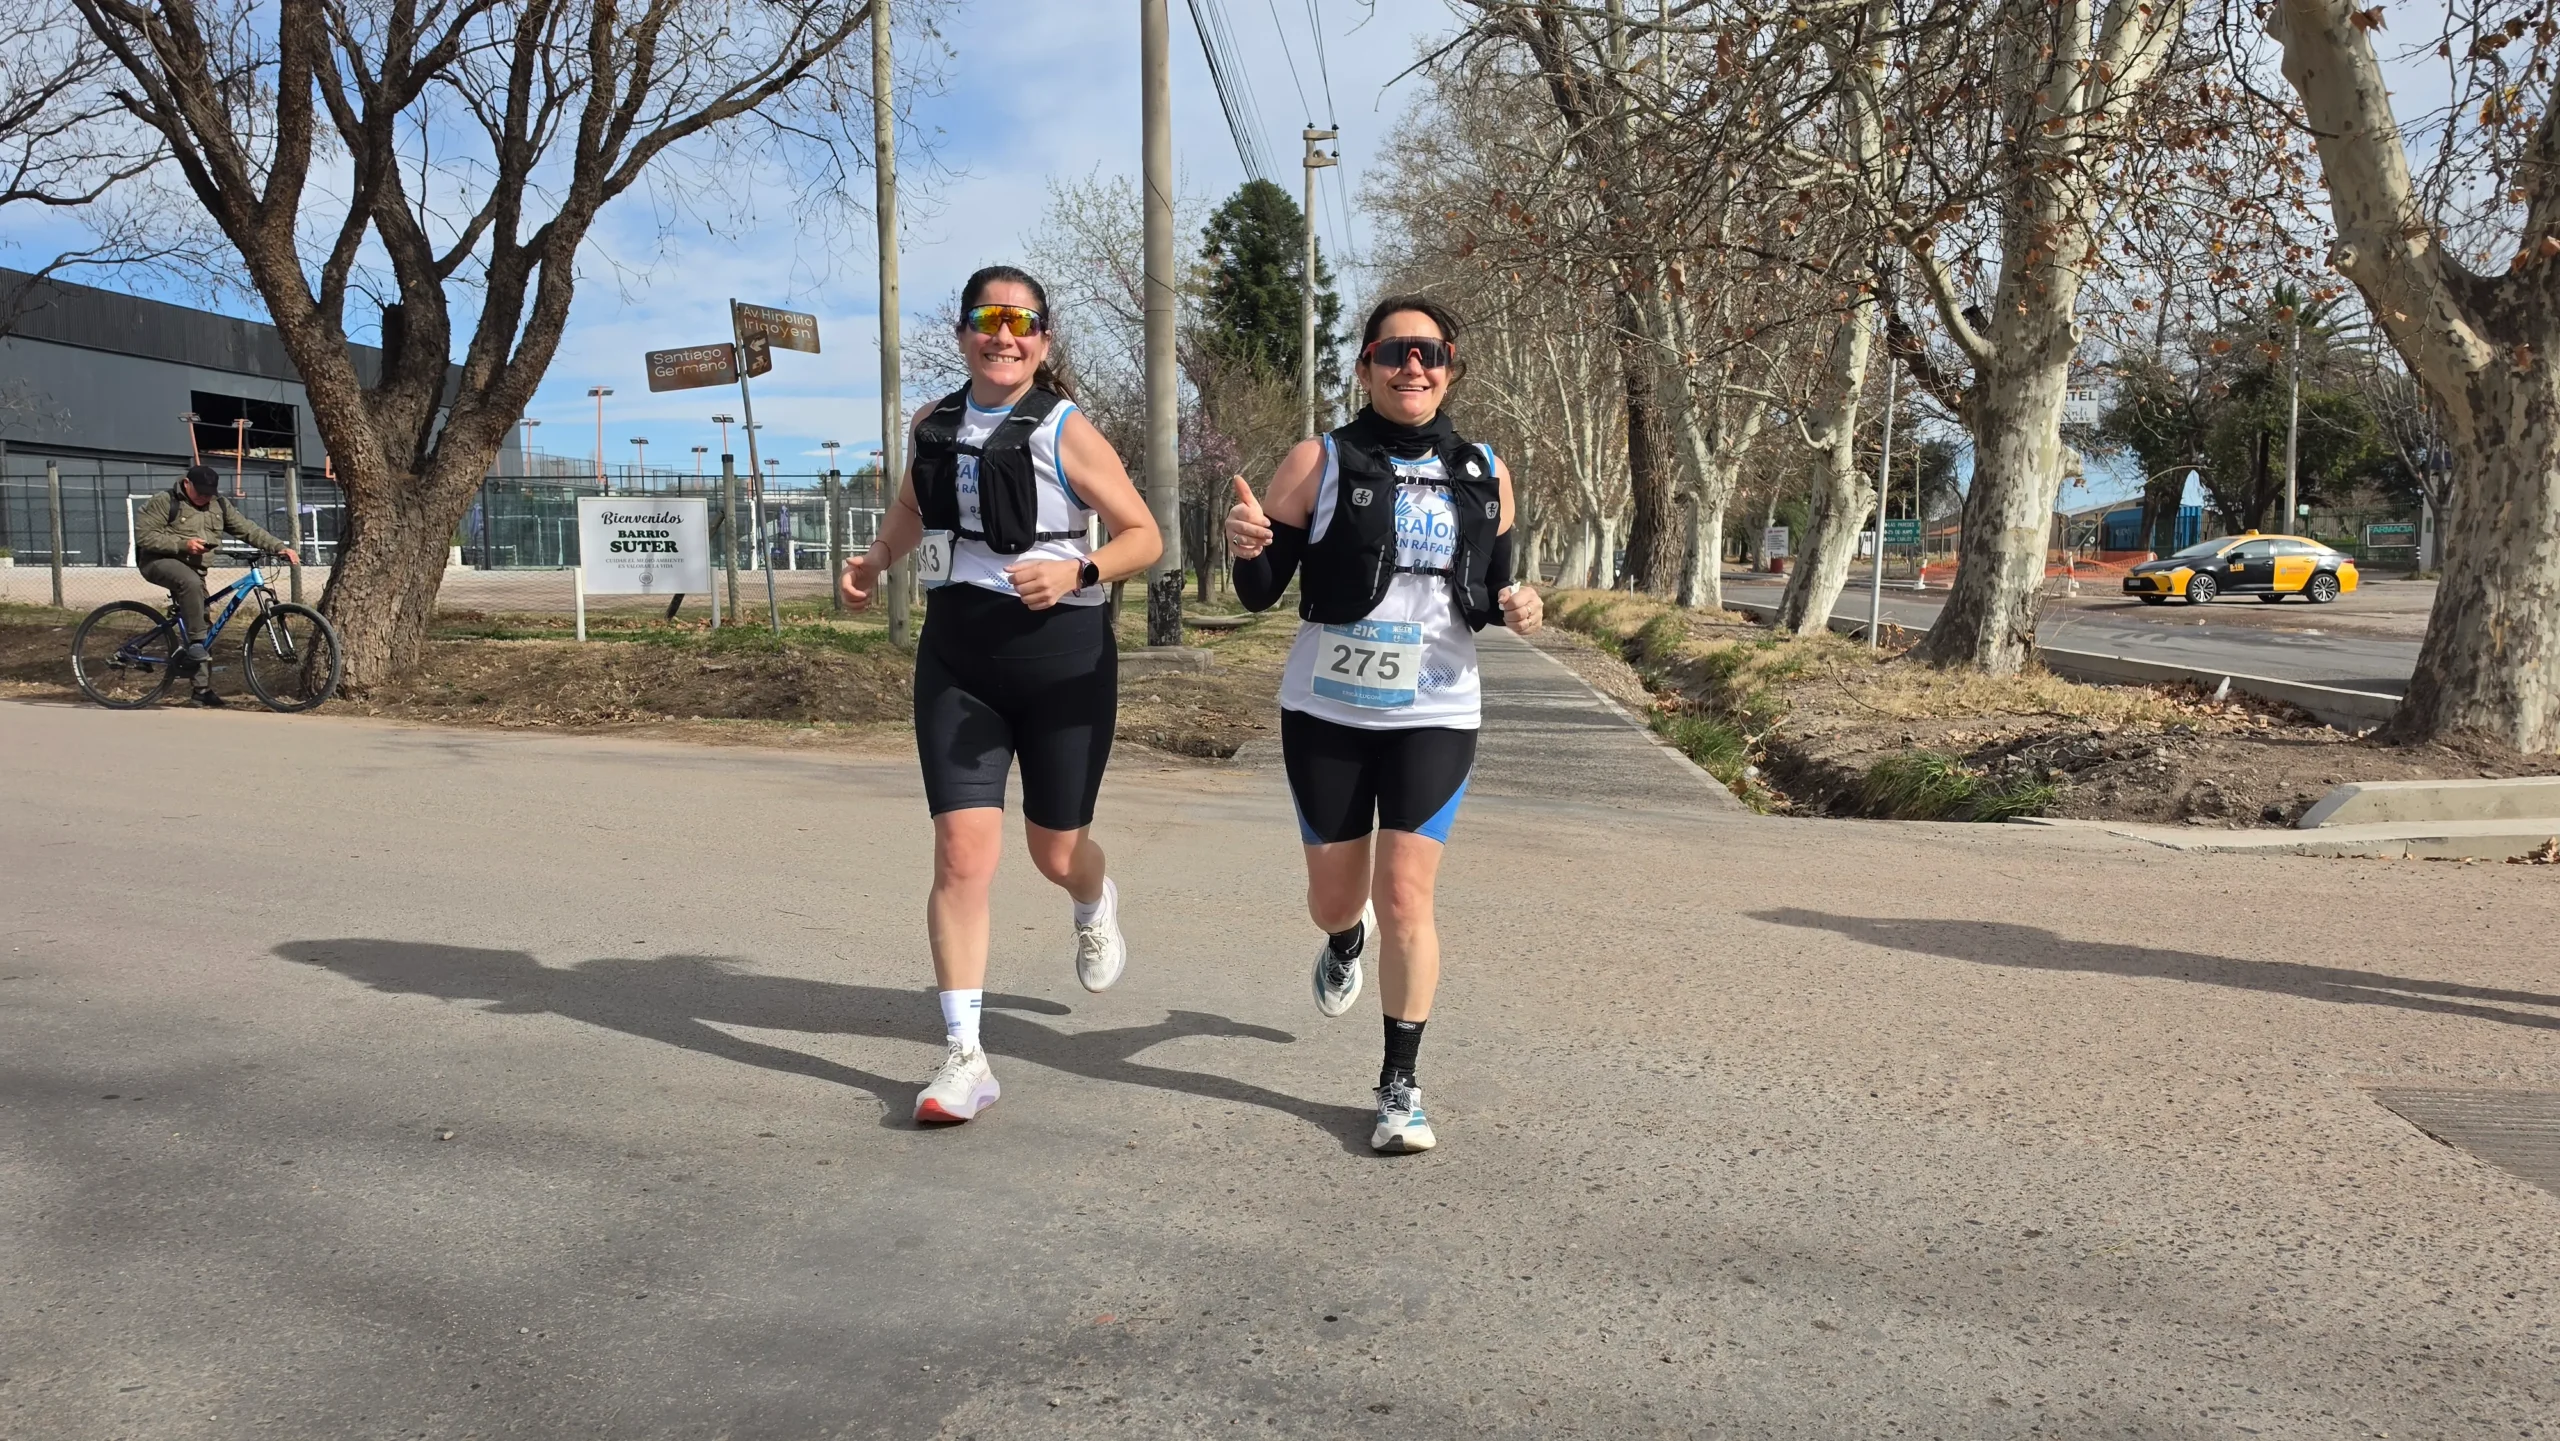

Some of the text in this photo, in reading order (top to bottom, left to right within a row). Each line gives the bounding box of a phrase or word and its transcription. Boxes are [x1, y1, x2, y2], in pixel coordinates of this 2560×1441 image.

[761, 308, 813, 327] Hipolito
[743, 318, 811, 339] Irigoyen
[653, 348, 722, 365] Santiago
[654, 357, 727, 377] Germanó
[601, 511, 685, 525] Bienvenidos
[618, 530, 670, 538] BARRIO
[2370, 525, 2414, 534] FARMACIA
[610, 540, 679, 553] SUTER
[1352, 624, 1380, 639] 21K
[1330, 644, 1400, 680] 275
